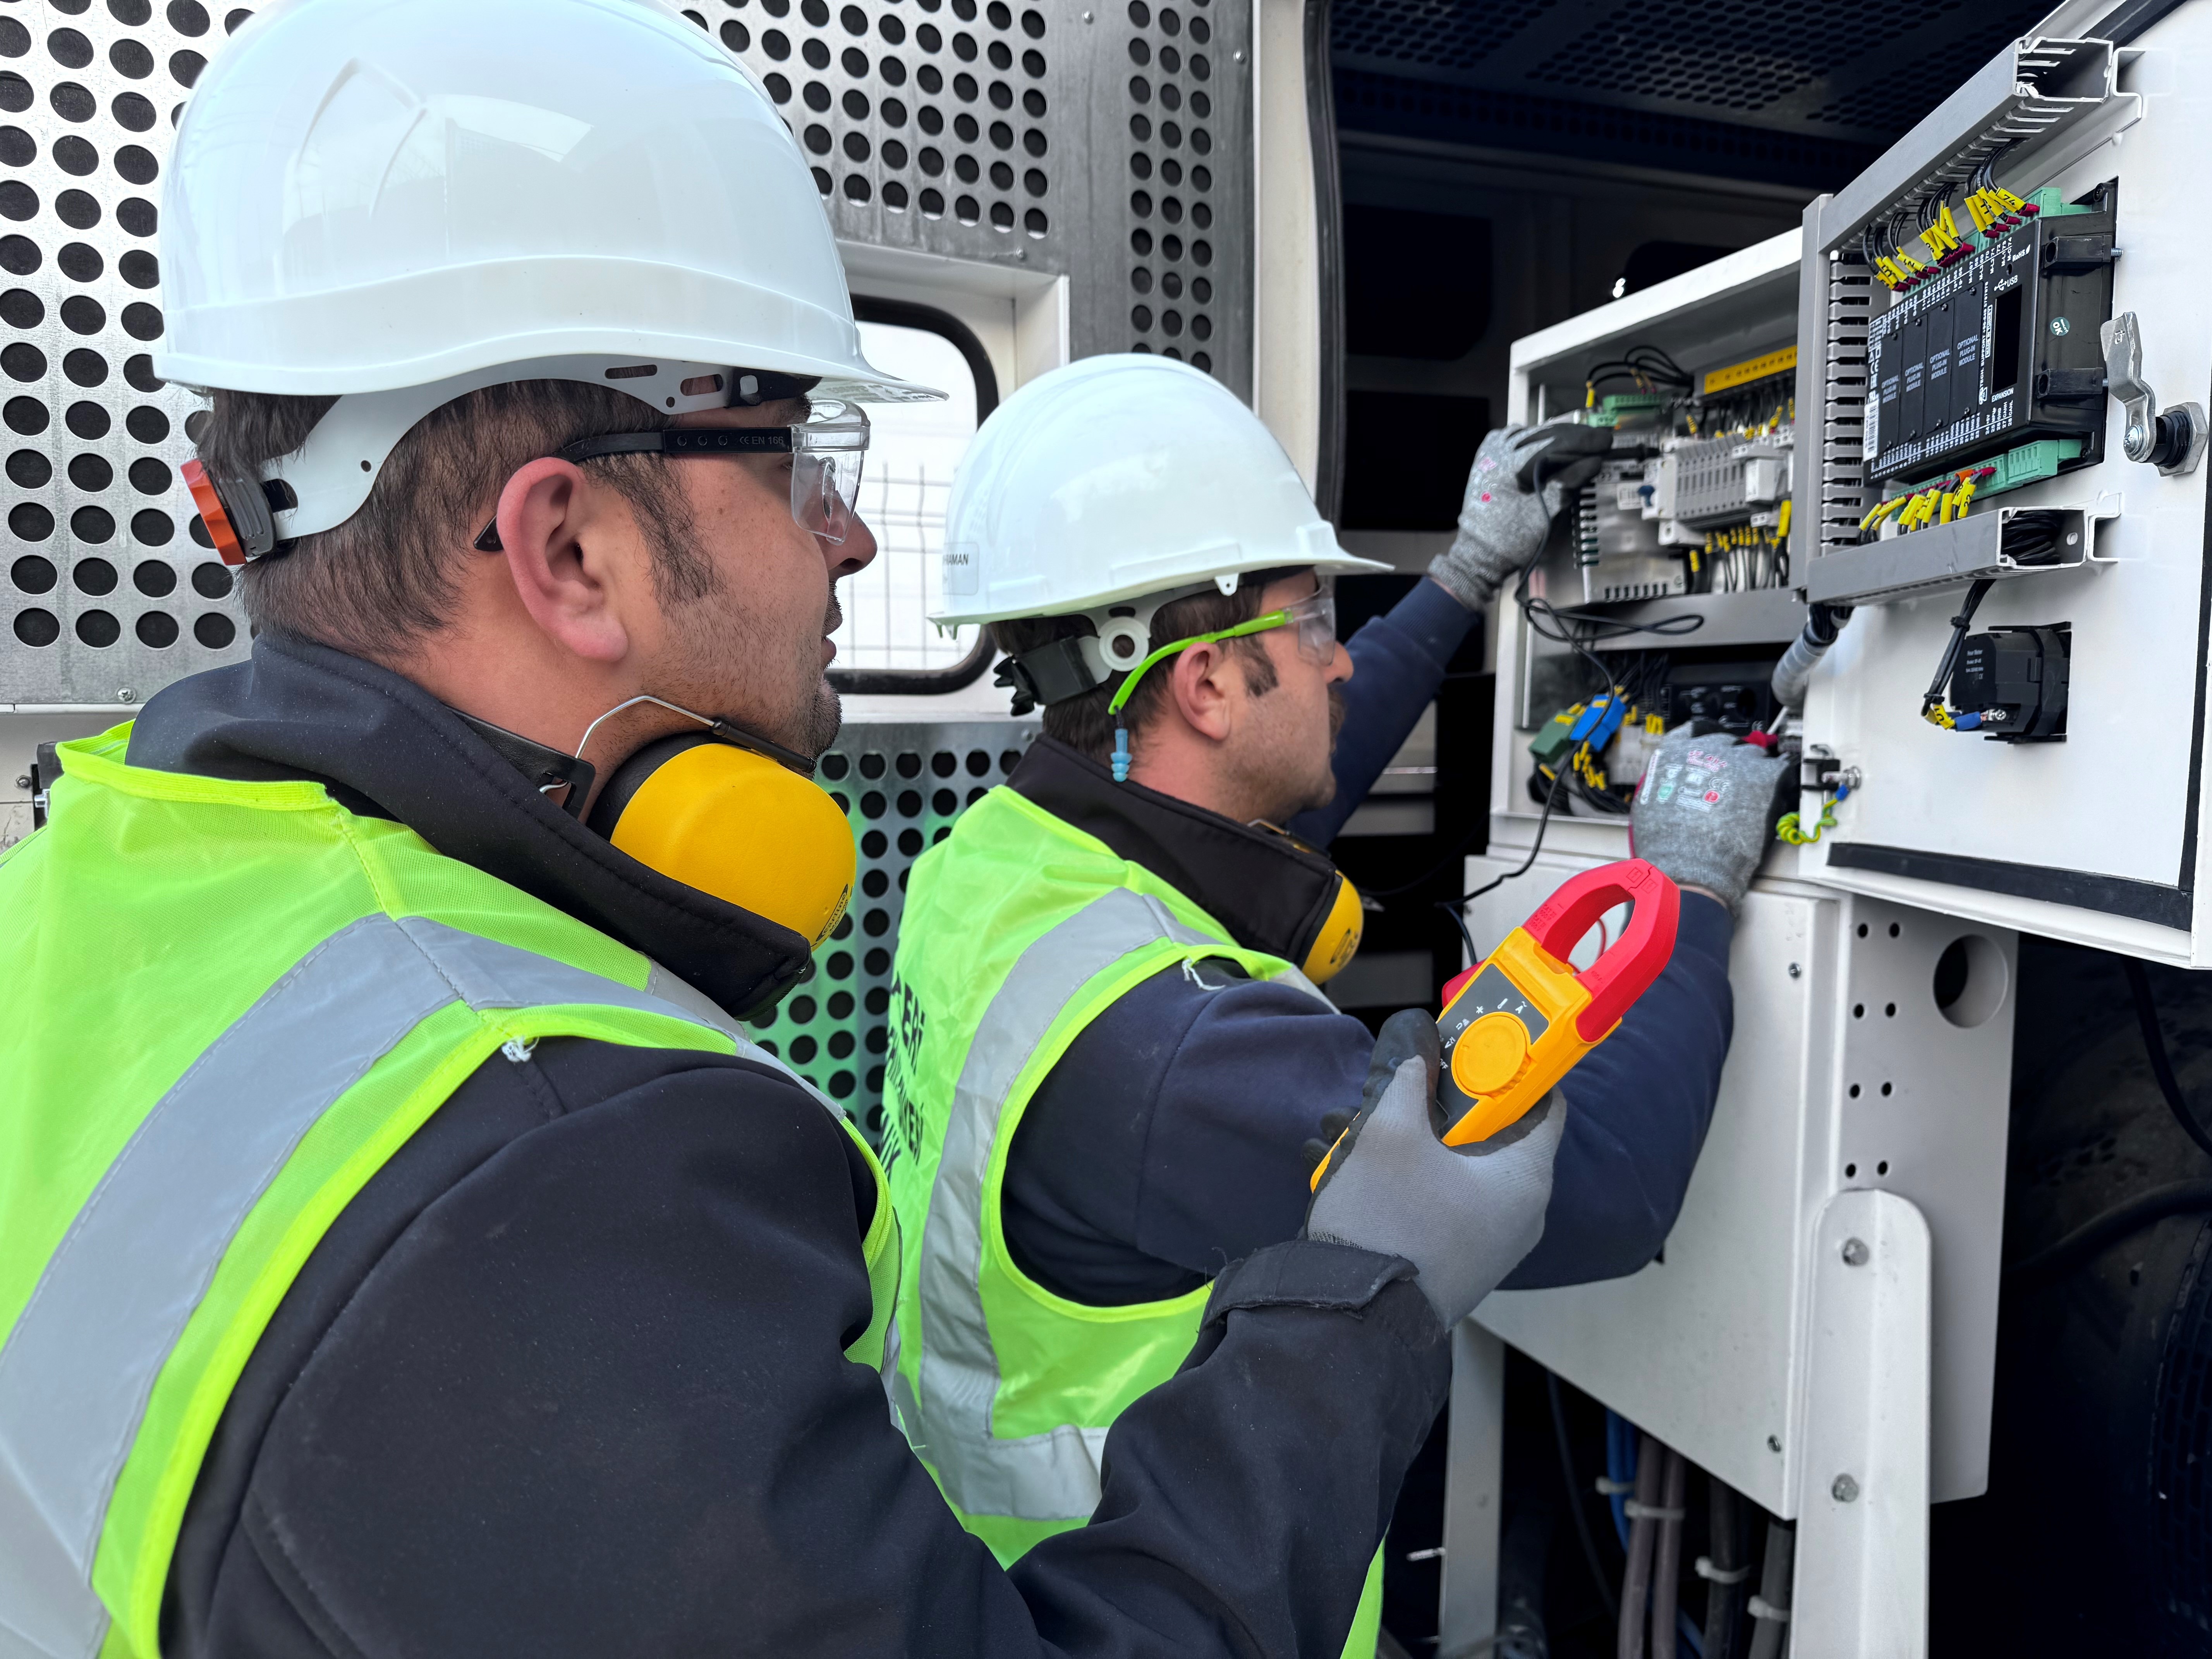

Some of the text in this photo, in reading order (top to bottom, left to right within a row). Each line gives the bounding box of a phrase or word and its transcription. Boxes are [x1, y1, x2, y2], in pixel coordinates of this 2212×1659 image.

[2007, 275, 2018, 287] USB
[2053, 321, 2063, 335] OK
[1957, 334, 1978, 350] OPTIONAL
[1930, 349, 1950, 364] OPTIONAL
[1958, 353, 1975, 366] MODULE
[1991, 387, 2013, 402] EXPANSION
